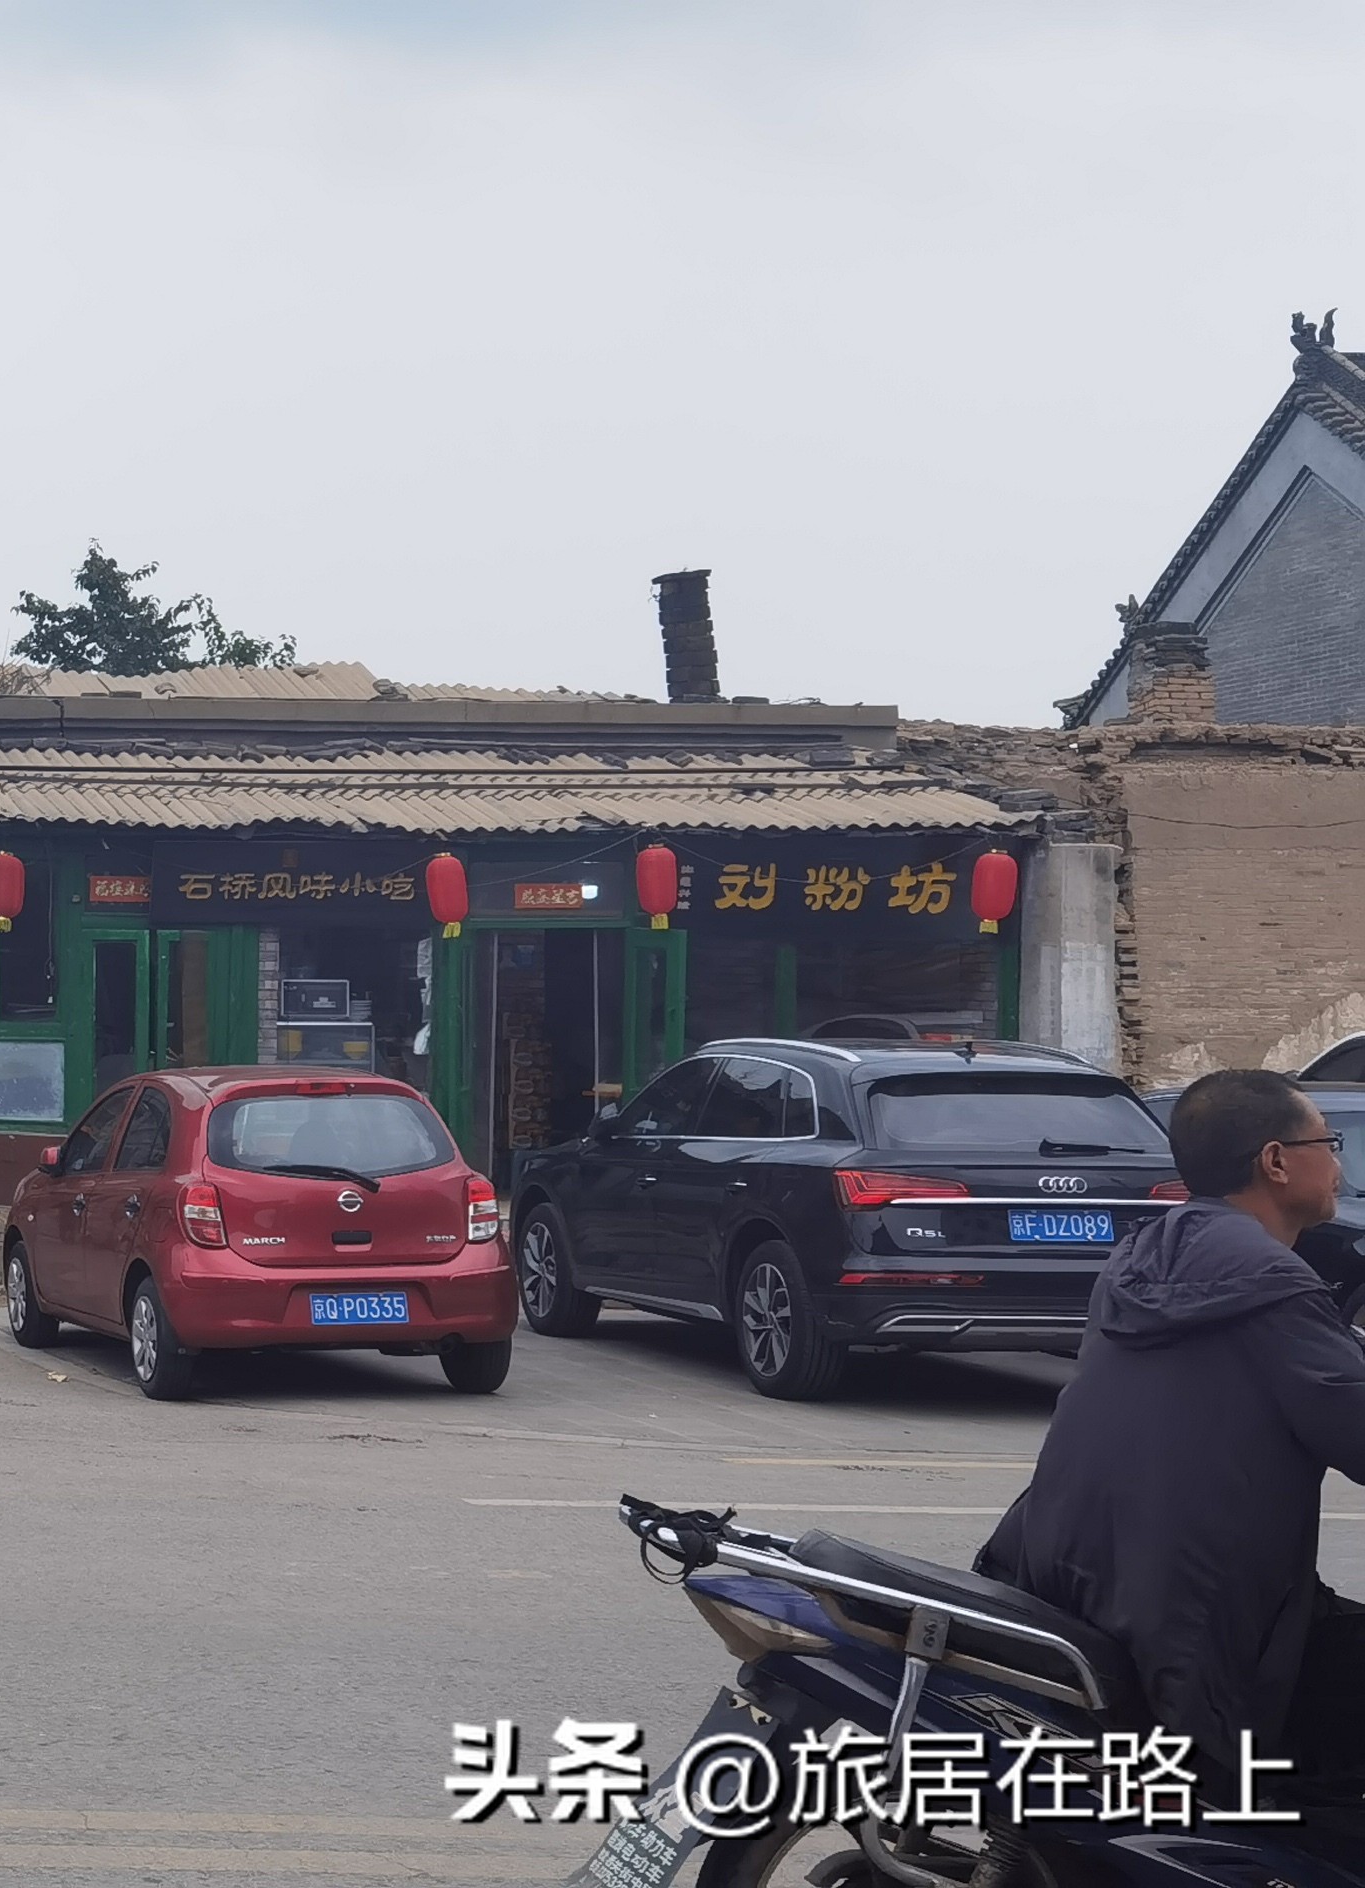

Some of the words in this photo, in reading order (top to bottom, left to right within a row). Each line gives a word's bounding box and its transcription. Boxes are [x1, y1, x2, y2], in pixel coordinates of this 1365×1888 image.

[178, 872, 415, 901] 石桥风味小吃
[714, 862, 958, 915] 刘粉坊
[242, 1236, 286, 1246] MARCH
[906, 1227, 946, 1238] Q5L
